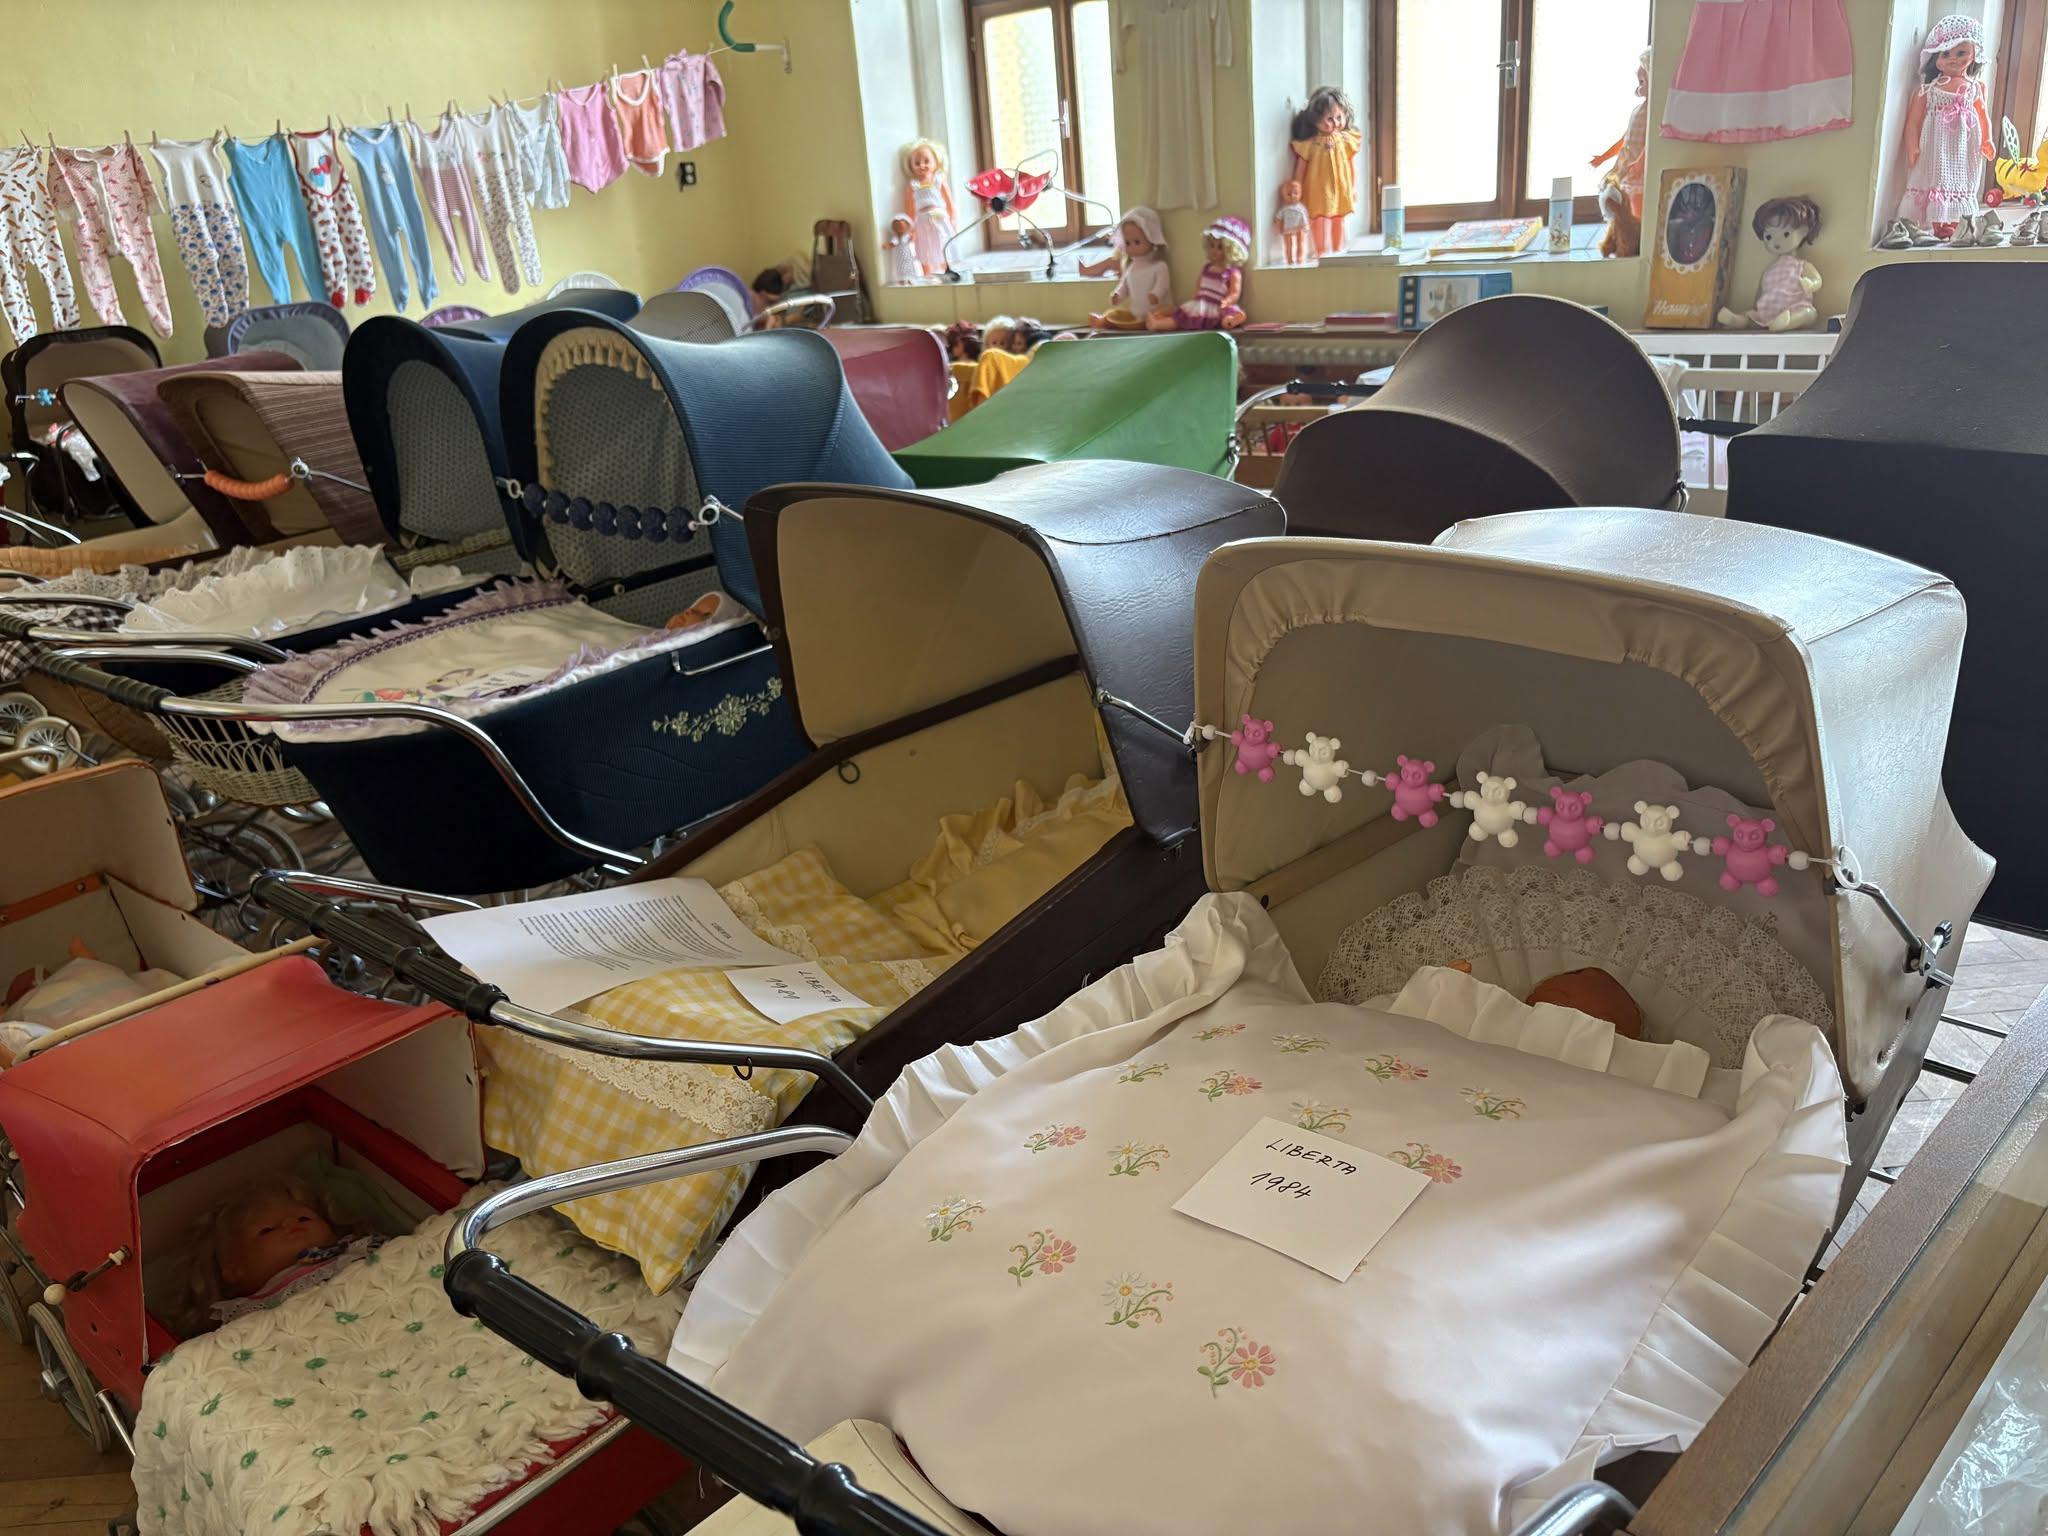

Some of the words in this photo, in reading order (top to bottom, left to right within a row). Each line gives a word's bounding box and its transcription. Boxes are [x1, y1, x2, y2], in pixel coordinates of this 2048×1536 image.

[765, 977, 801, 999] 1984
[798, 970, 842, 1003] LIBERTA
[1265, 1138, 1357, 1175] LIBERTA
[1250, 1172, 1312, 1199] 1984
